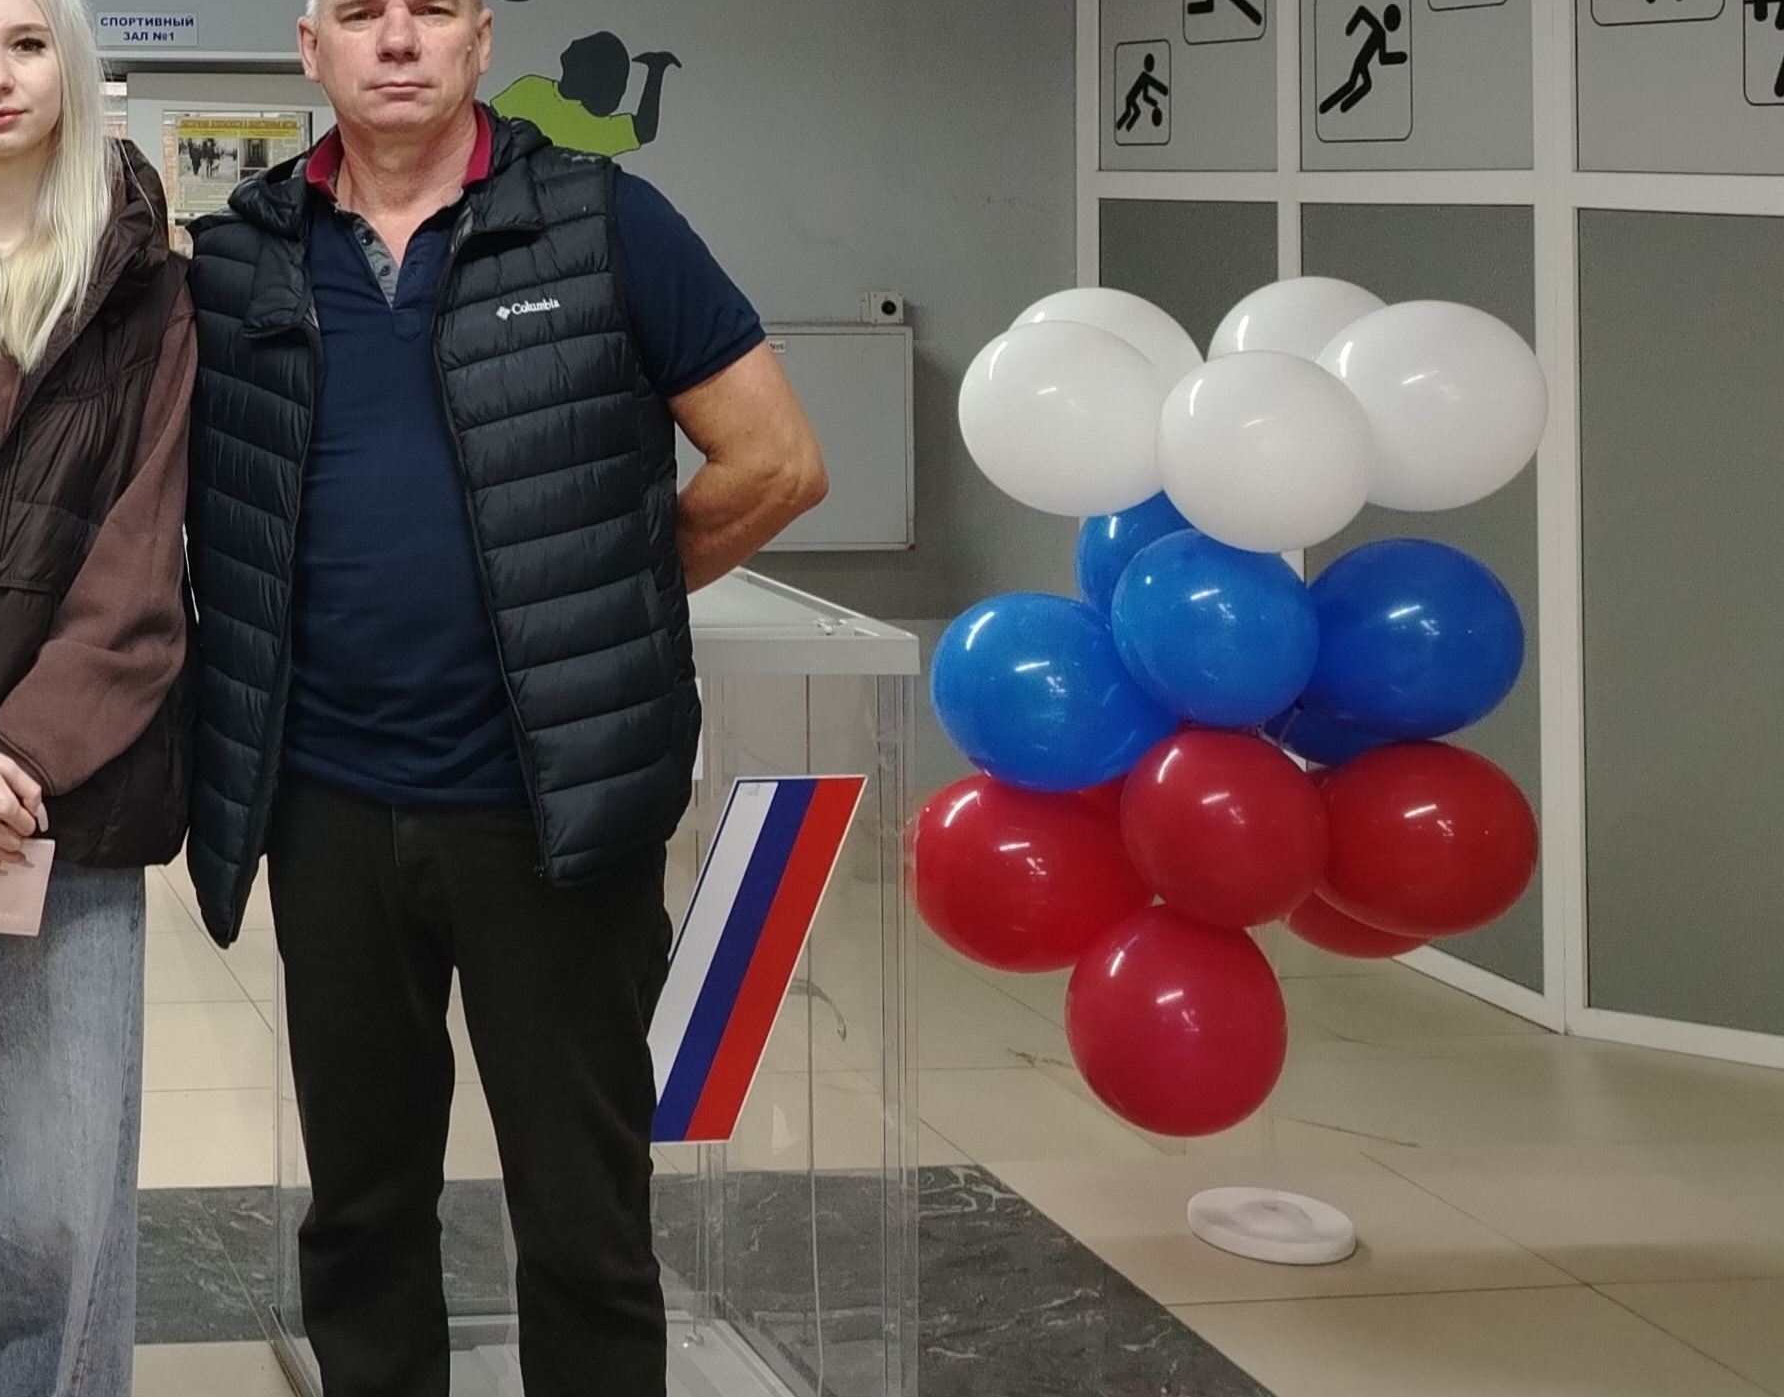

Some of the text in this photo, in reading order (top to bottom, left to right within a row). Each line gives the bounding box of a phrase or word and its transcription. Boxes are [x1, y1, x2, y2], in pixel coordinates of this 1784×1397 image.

[100, 15, 194, 27] СПОРТИВНЫЙ
[123, 31, 174, 41] ЗАЛ №1
[511, 298, 560, 315] Columbia
